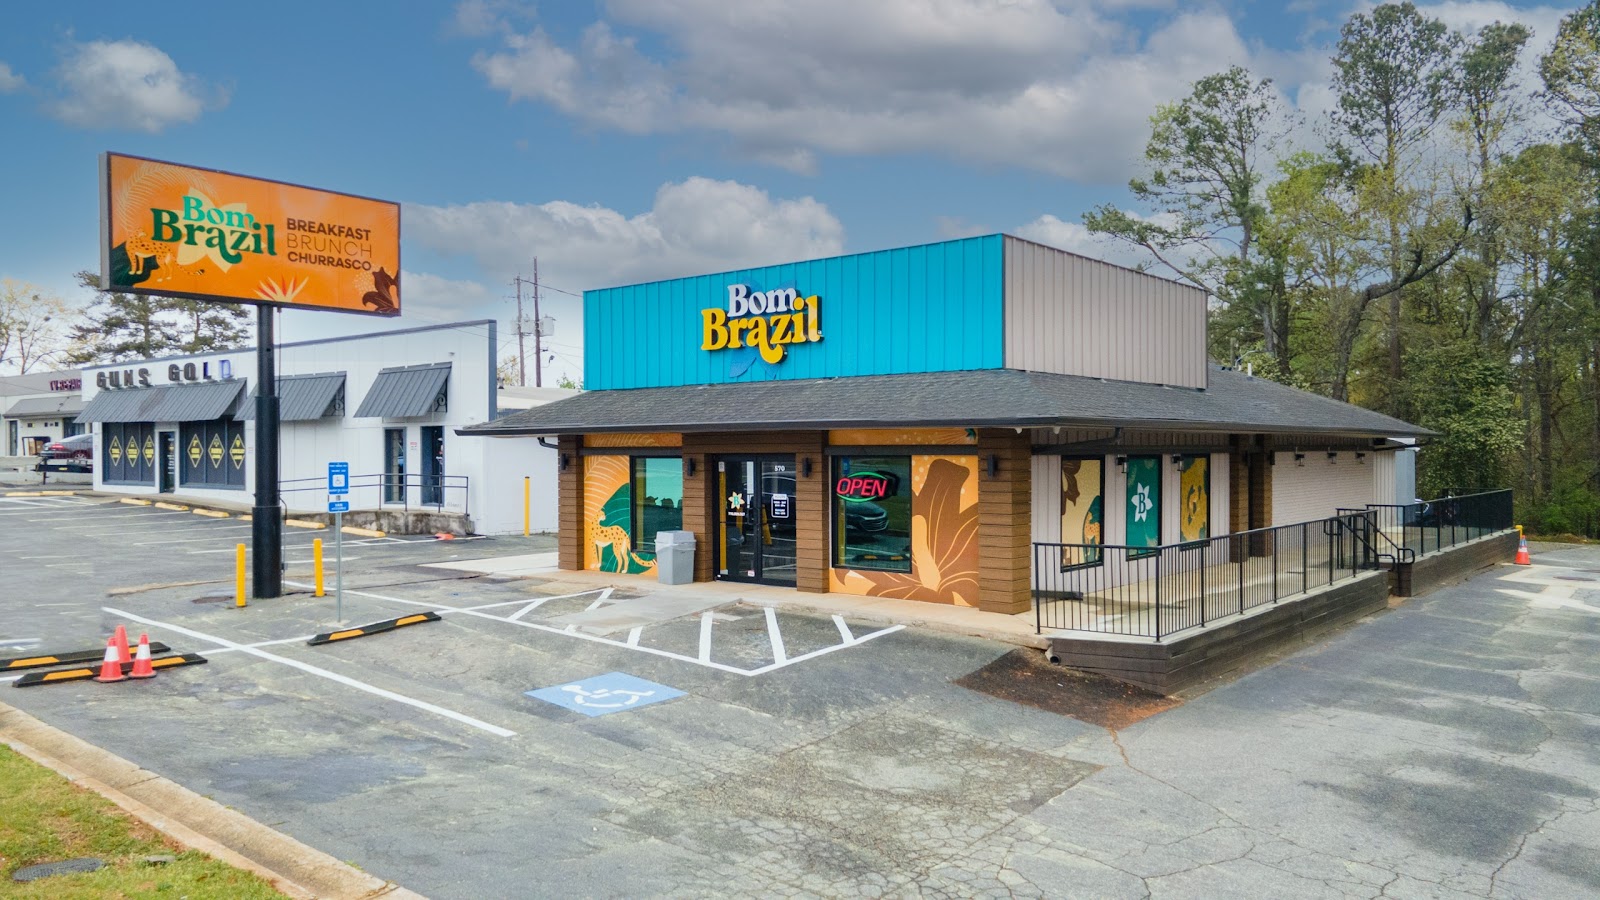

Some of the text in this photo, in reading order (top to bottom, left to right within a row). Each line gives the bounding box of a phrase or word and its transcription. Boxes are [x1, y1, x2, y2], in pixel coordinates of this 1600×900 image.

[182, 195, 255, 229] Bom
[150, 208, 277, 264] Brazil
[287, 217, 372, 241] BREAKFAST
[287, 232, 372, 259] BRUNCH
[287, 251, 372, 271] CHURRASCO
[727, 283, 797, 317] Bom
[700, 295, 821, 364] Brazil
[96, 359, 232, 389] GUNS GOLD
[836, 477, 887, 497] OPEN
[1138, 492, 1146, 514] B
